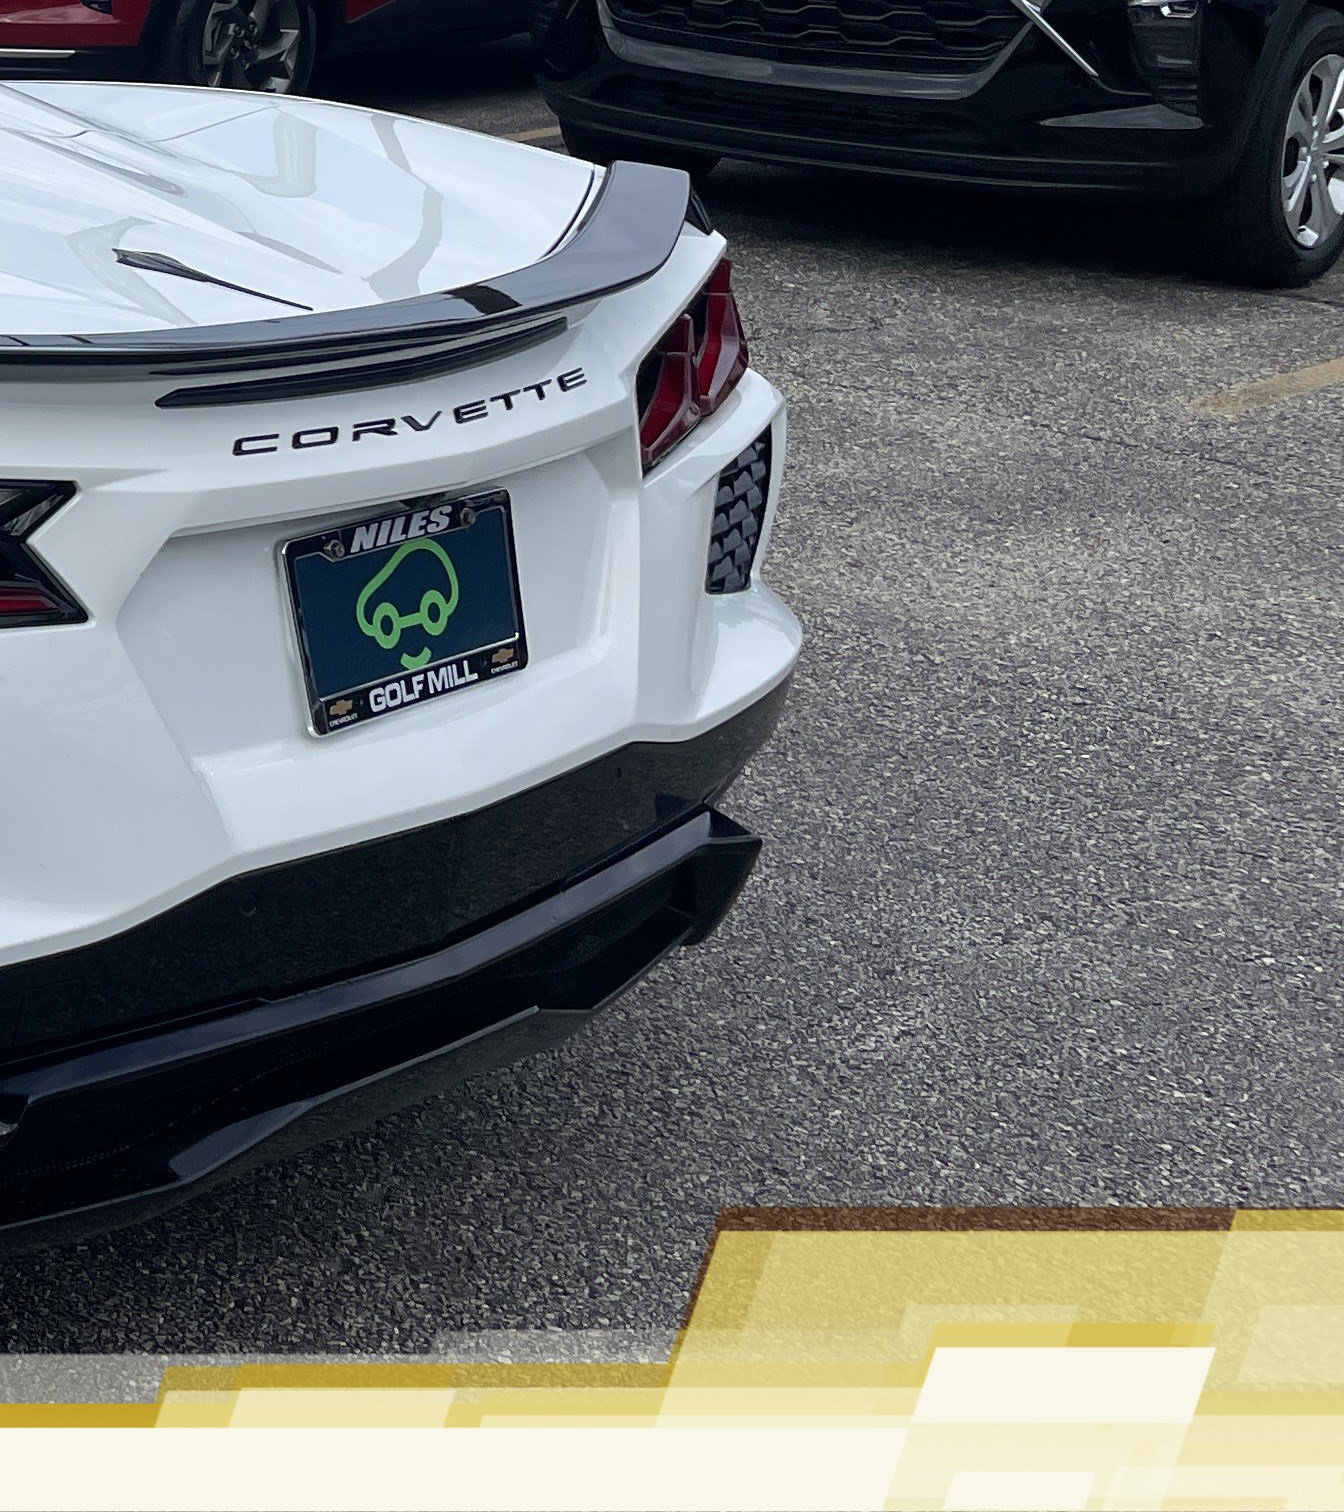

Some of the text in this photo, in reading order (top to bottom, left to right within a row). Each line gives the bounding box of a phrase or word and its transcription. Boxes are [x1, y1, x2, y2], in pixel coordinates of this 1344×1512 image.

[231, 366, 589, 456] CORVETTE
[350, 505, 452, 554] NILES
[369, 660, 479, 713] GOLF MILL
